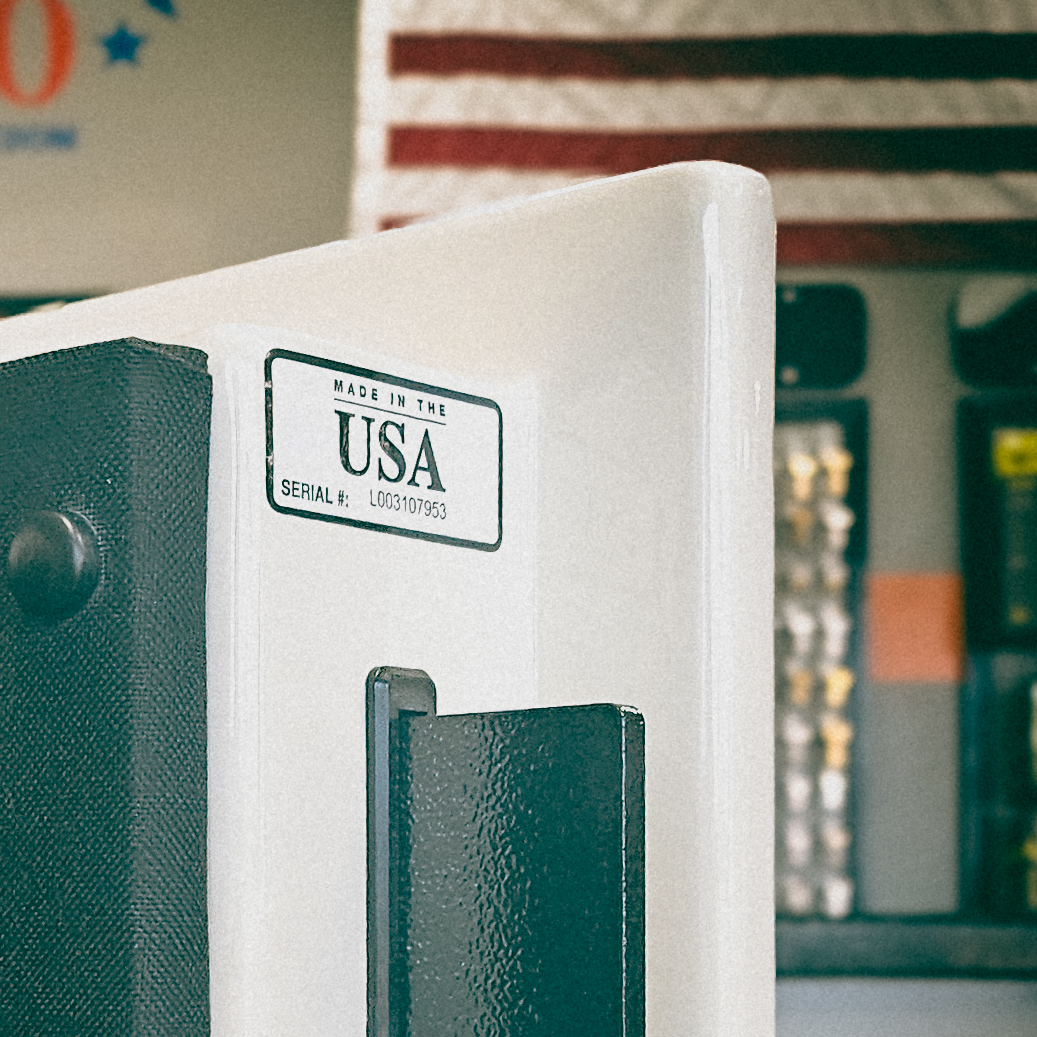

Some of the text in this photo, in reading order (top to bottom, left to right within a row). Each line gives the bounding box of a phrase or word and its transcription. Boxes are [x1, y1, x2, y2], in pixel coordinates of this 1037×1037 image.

[334, 379, 446, 416] MADE IN THE
[334, 409, 446, 492] USA
[281, 478, 447, 520] SERIAL #: L003107953
